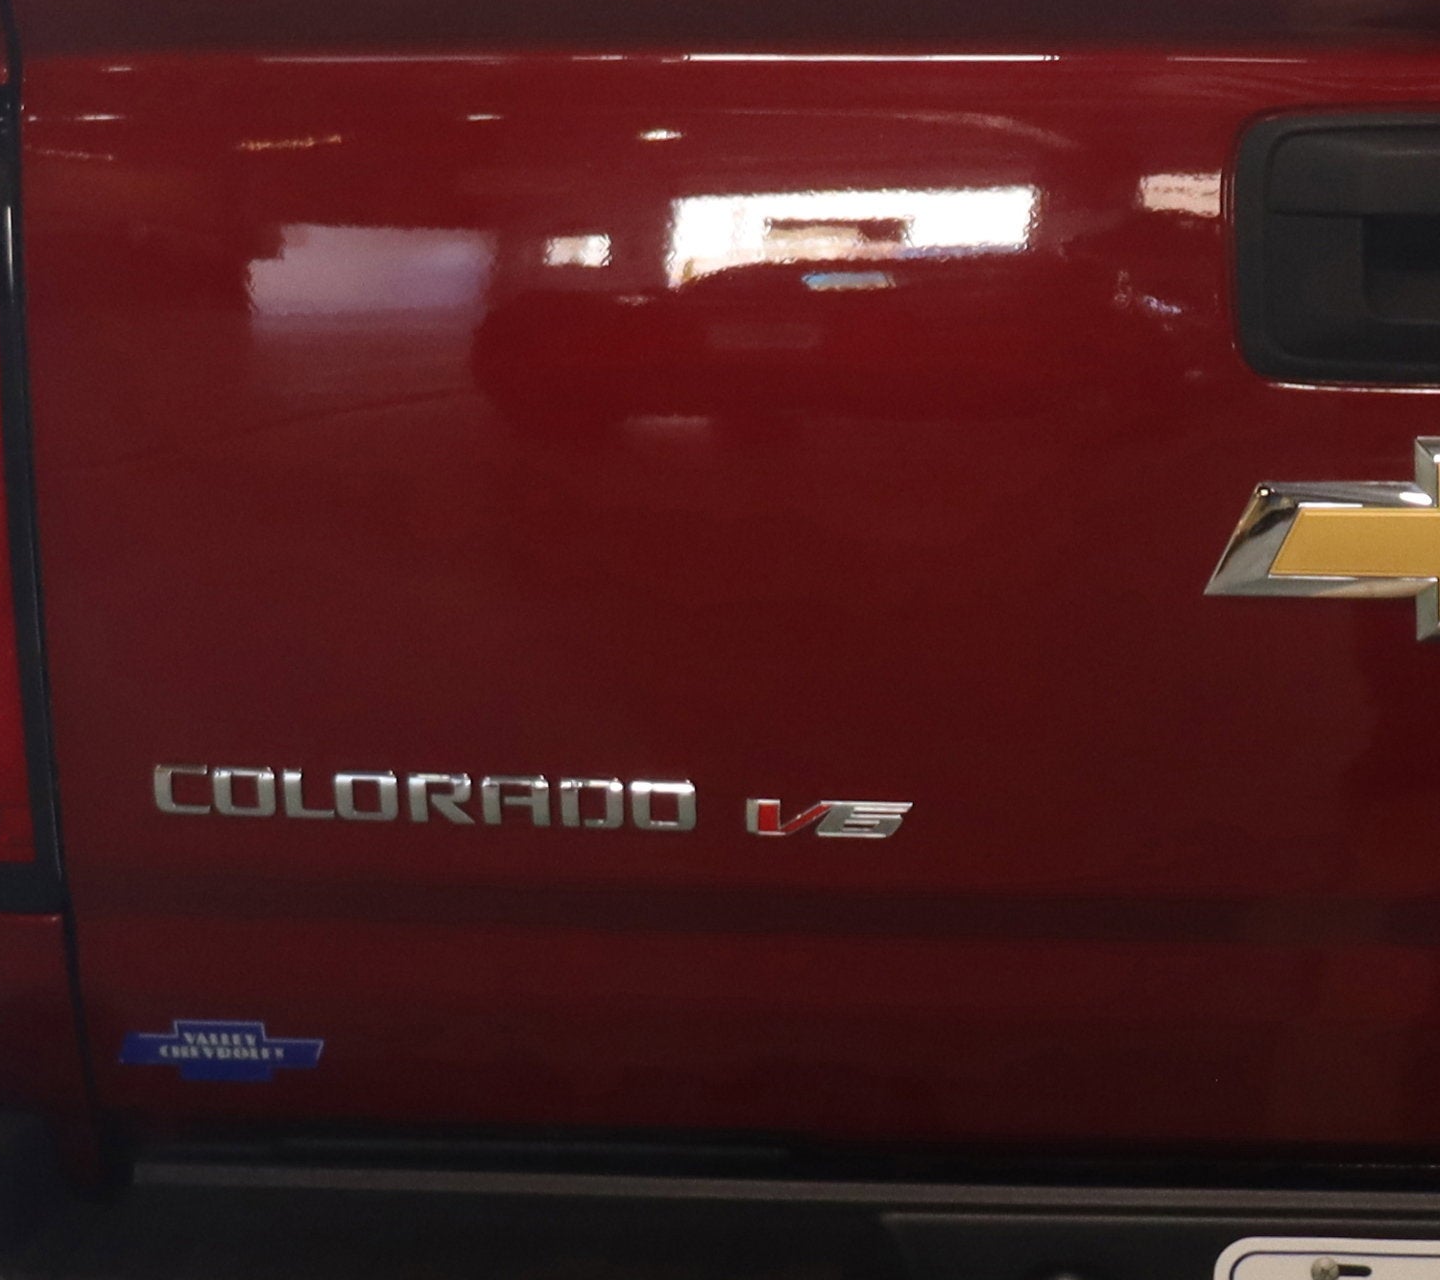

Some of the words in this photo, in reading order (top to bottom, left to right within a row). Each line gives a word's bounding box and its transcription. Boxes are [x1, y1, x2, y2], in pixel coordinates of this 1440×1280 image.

[154, 764, 696, 831] COLORADO
[746, 798, 913, 838] V6
[182, 1031, 257, 1046] VALLEY
[159, 1044, 285, 1060] CHEVROLET
